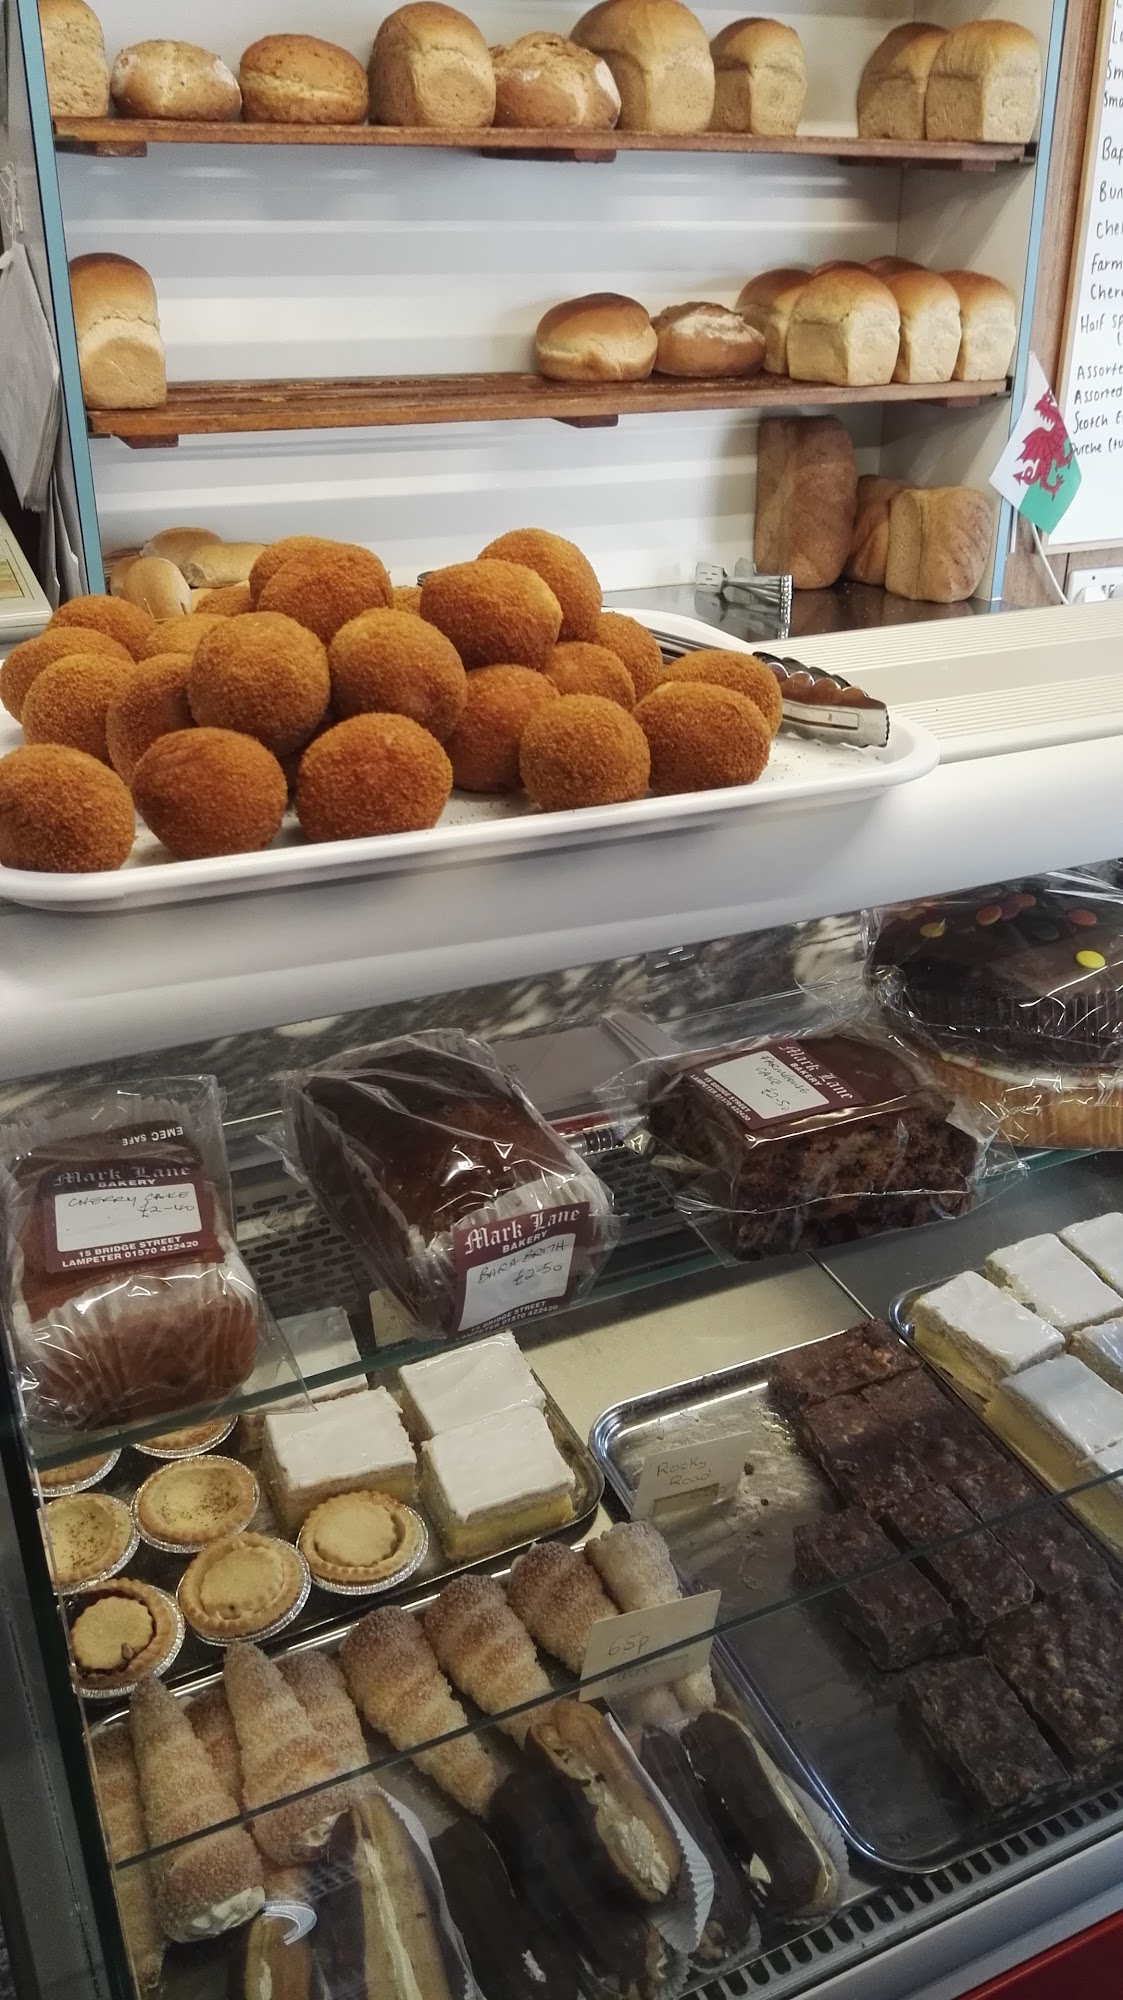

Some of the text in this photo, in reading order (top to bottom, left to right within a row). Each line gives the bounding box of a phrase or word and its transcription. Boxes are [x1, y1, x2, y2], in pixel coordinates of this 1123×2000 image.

[1080, 313, 1105, 334] Half
[1073, 410, 1108, 434] Scotch
[778, 1046, 853, 1099] Mark Lane
[790, 1062, 822, 1086] BAKERY
[729, 1095, 751, 1112] STREET
[121, 1126, 184, 1146] EMEC SAFE
[53, 1166, 191, 1187] Mark Lane
[98, 1179, 156, 1188] BAKERY
[68, 1191, 190, 1207] CHERRY CAKE
[465, 1209, 580, 1255] Mark Lane
[502, 1230, 548, 1253] BAKERY
[62, 1240, 199, 1268] LAMPETER 01570 422420
[95, 1243, 137, 1255] BRIDGE
[139, 1236, 182, 1248] STREET
[483, 1312, 512, 1328] BRIDGE
[514, 1300, 547, 1314] STREET
[502, 1312, 526, 1325] 01570
[528, 1305, 558, 1316] 422420
[657, 1456, 707, 1478] Rocky
[670, 1468, 711, 1485] Road
[608, 1633, 650, 1656] 65p
